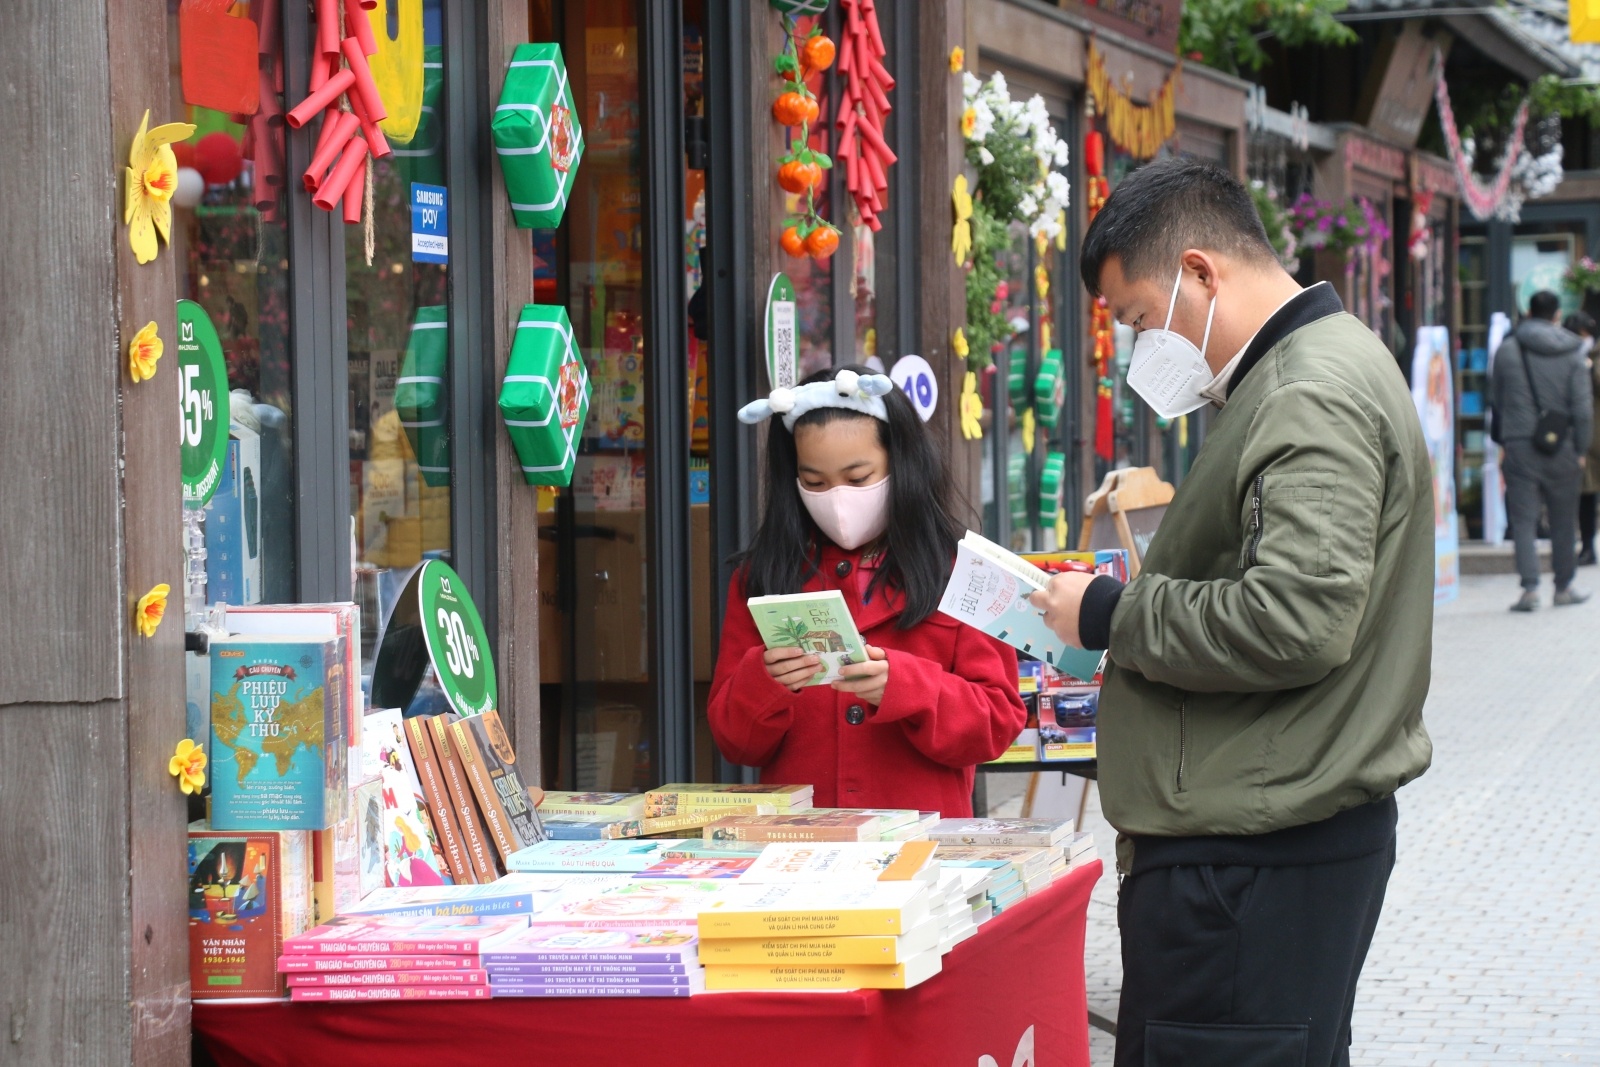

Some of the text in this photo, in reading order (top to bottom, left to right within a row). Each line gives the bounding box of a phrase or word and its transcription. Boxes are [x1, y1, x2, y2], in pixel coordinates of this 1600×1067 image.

[416, 190, 444, 206] SAMSUNG
[422, 208, 438, 230] pay
[960, 593, 978, 616] HÀI
[809, 608, 830, 617] Chí
[438, 608, 479, 678] 30%
[242, 680, 287, 694] PHIÊU
[251, 695, 280, 708] LƯU
[488, 810, 507, 846] SHERLOCK
[438, 808, 464, 874] SHERLOCK HOLMES
[461, 807, 487, 873] SHERLOCK HOLMES
[585, 859, 600, 867] HIỆU
[492, 901, 510, 910] biết
[204, 948, 223, 956] VIỆT
[320, 943, 332, 952] THAI
[380, 943, 390, 951] GIA
[393, 942, 403, 951] 280
[315, 961, 328, 969] THAI
[377, 960, 387, 968] GIA
[390, 959, 401, 967] 280
[385, 975, 395, 983] GIA
[398, 974, 409, 982] 280
